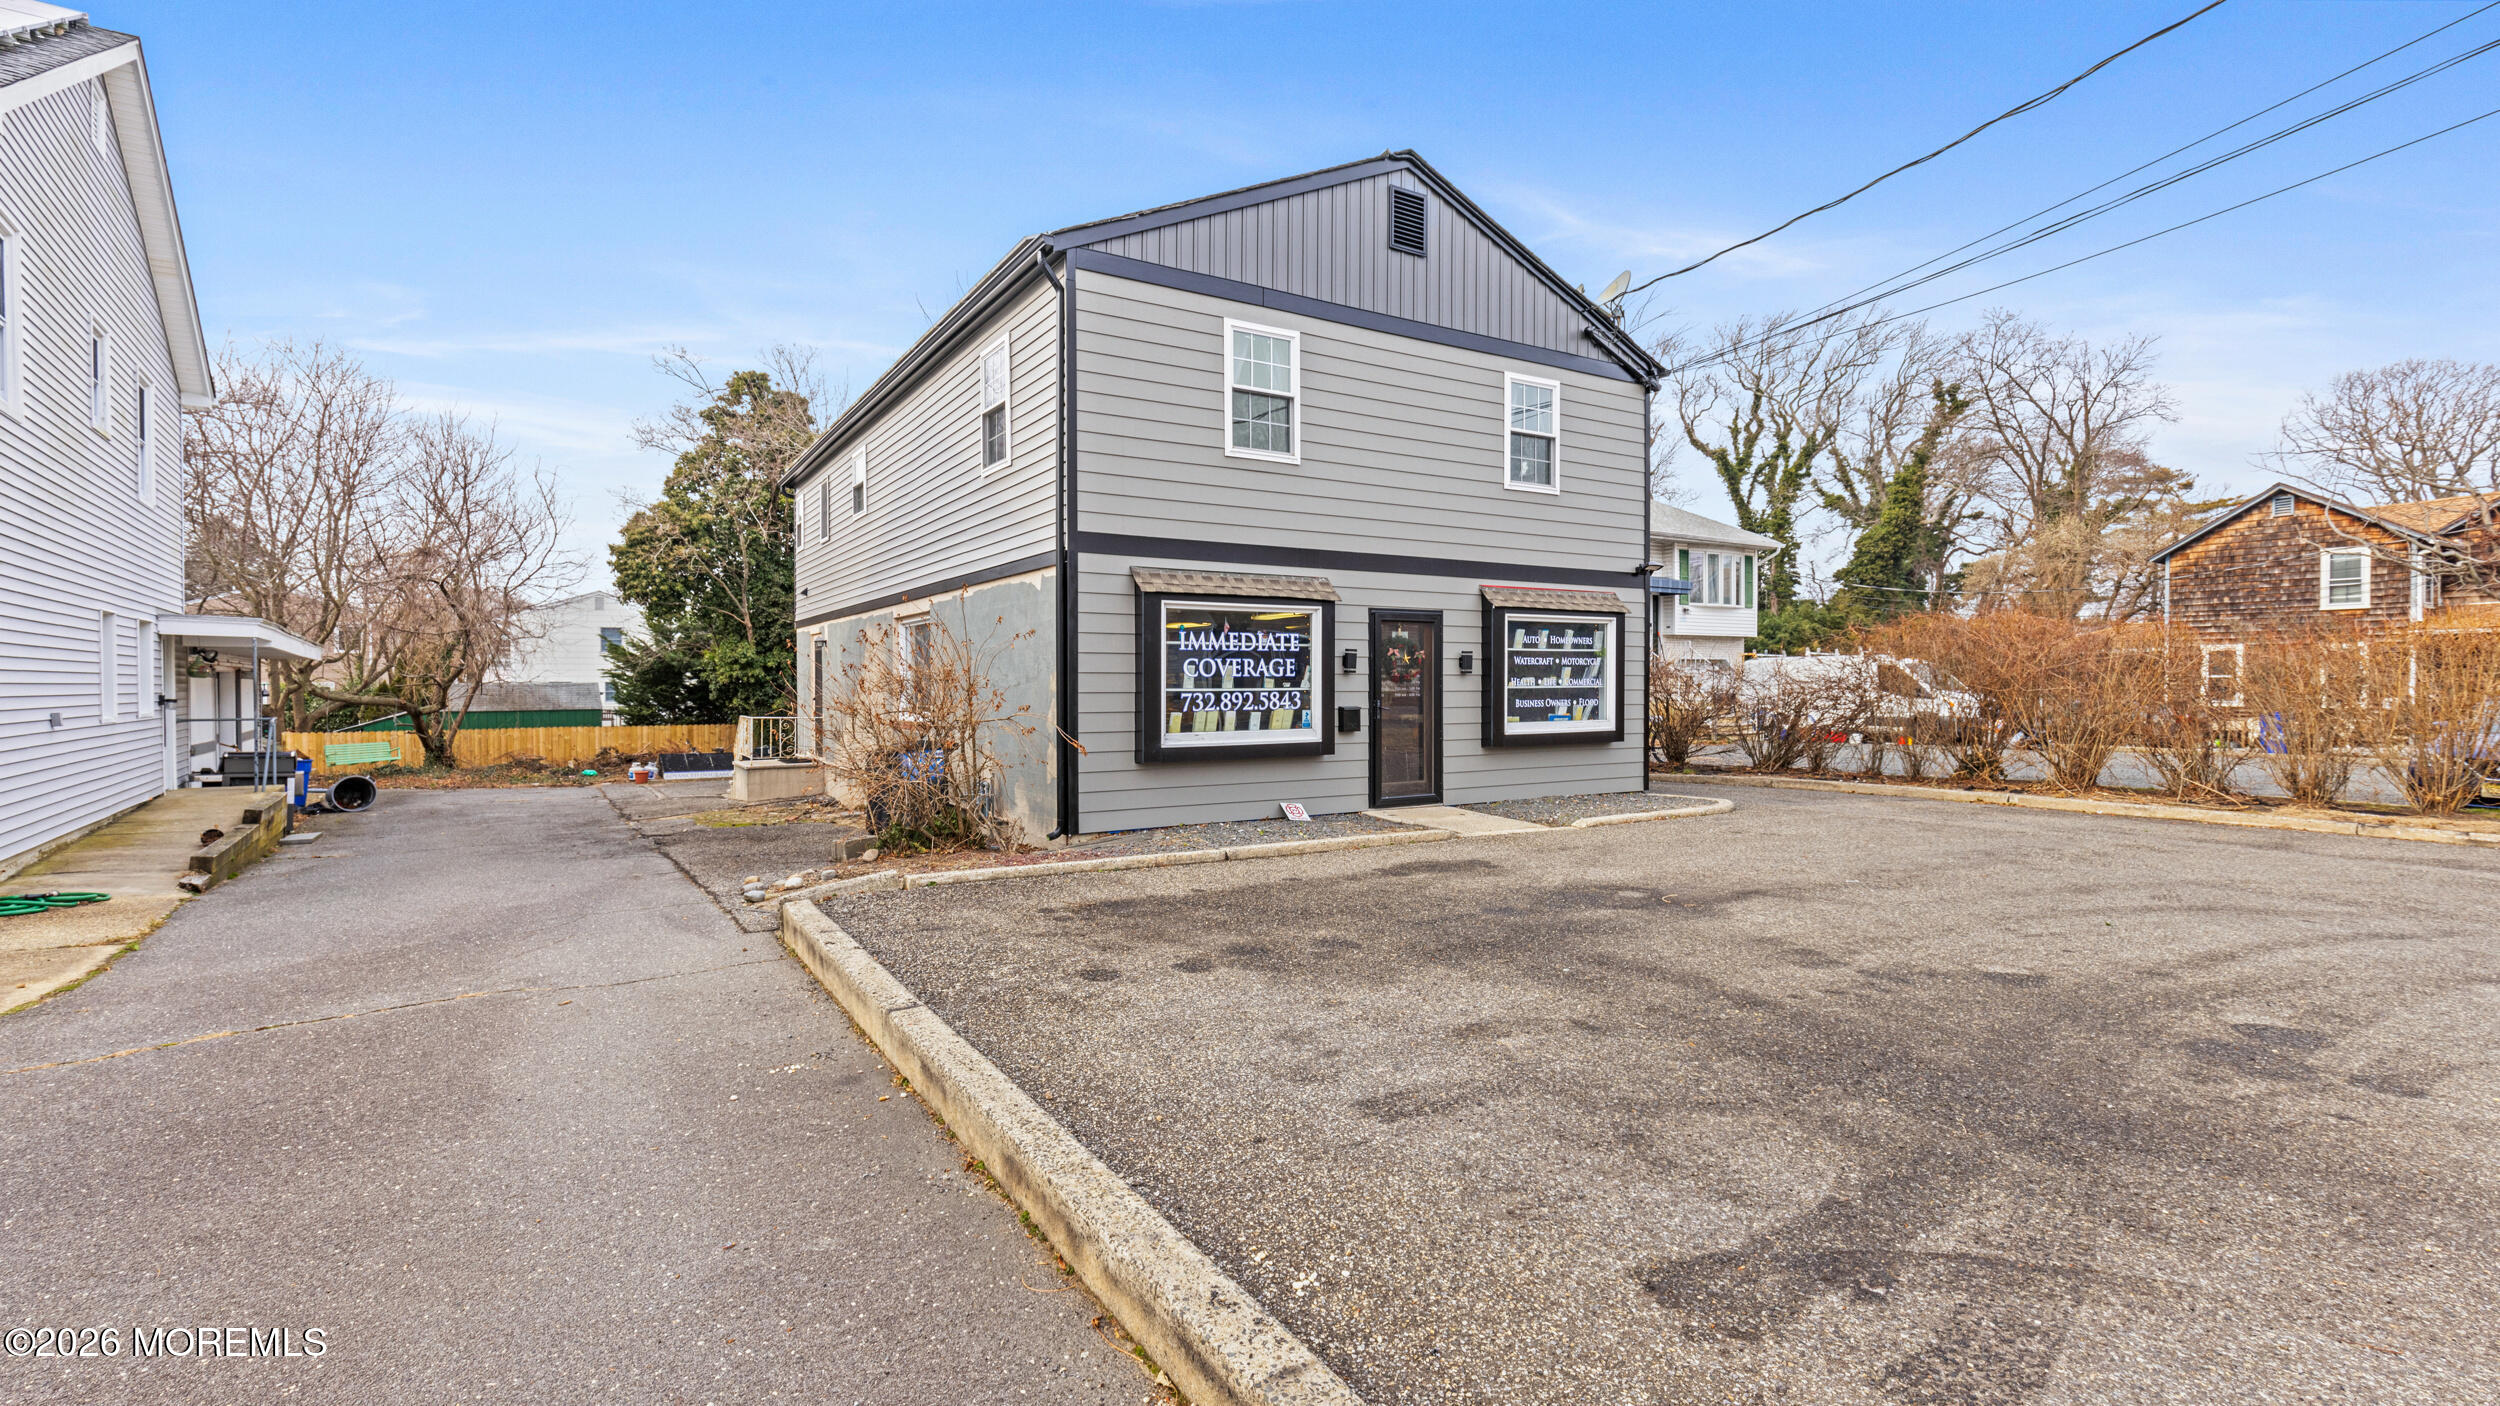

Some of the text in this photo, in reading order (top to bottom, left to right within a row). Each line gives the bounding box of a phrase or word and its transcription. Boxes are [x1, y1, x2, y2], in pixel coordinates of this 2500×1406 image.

[1178, 631, 1300, 652] IMMEDIATE
[1523, 635, 1541, 644] AUTO
[1183, 657, 1297, 678] COVERAGE
[1513, 655, 1554, 666] WATERCRAFT
[1180, 691, 1301, 713] 732.892.5843
[1515, 698, 1544, 708] BUSINESS
[1545, 698, 1571, 707] OWNERS
